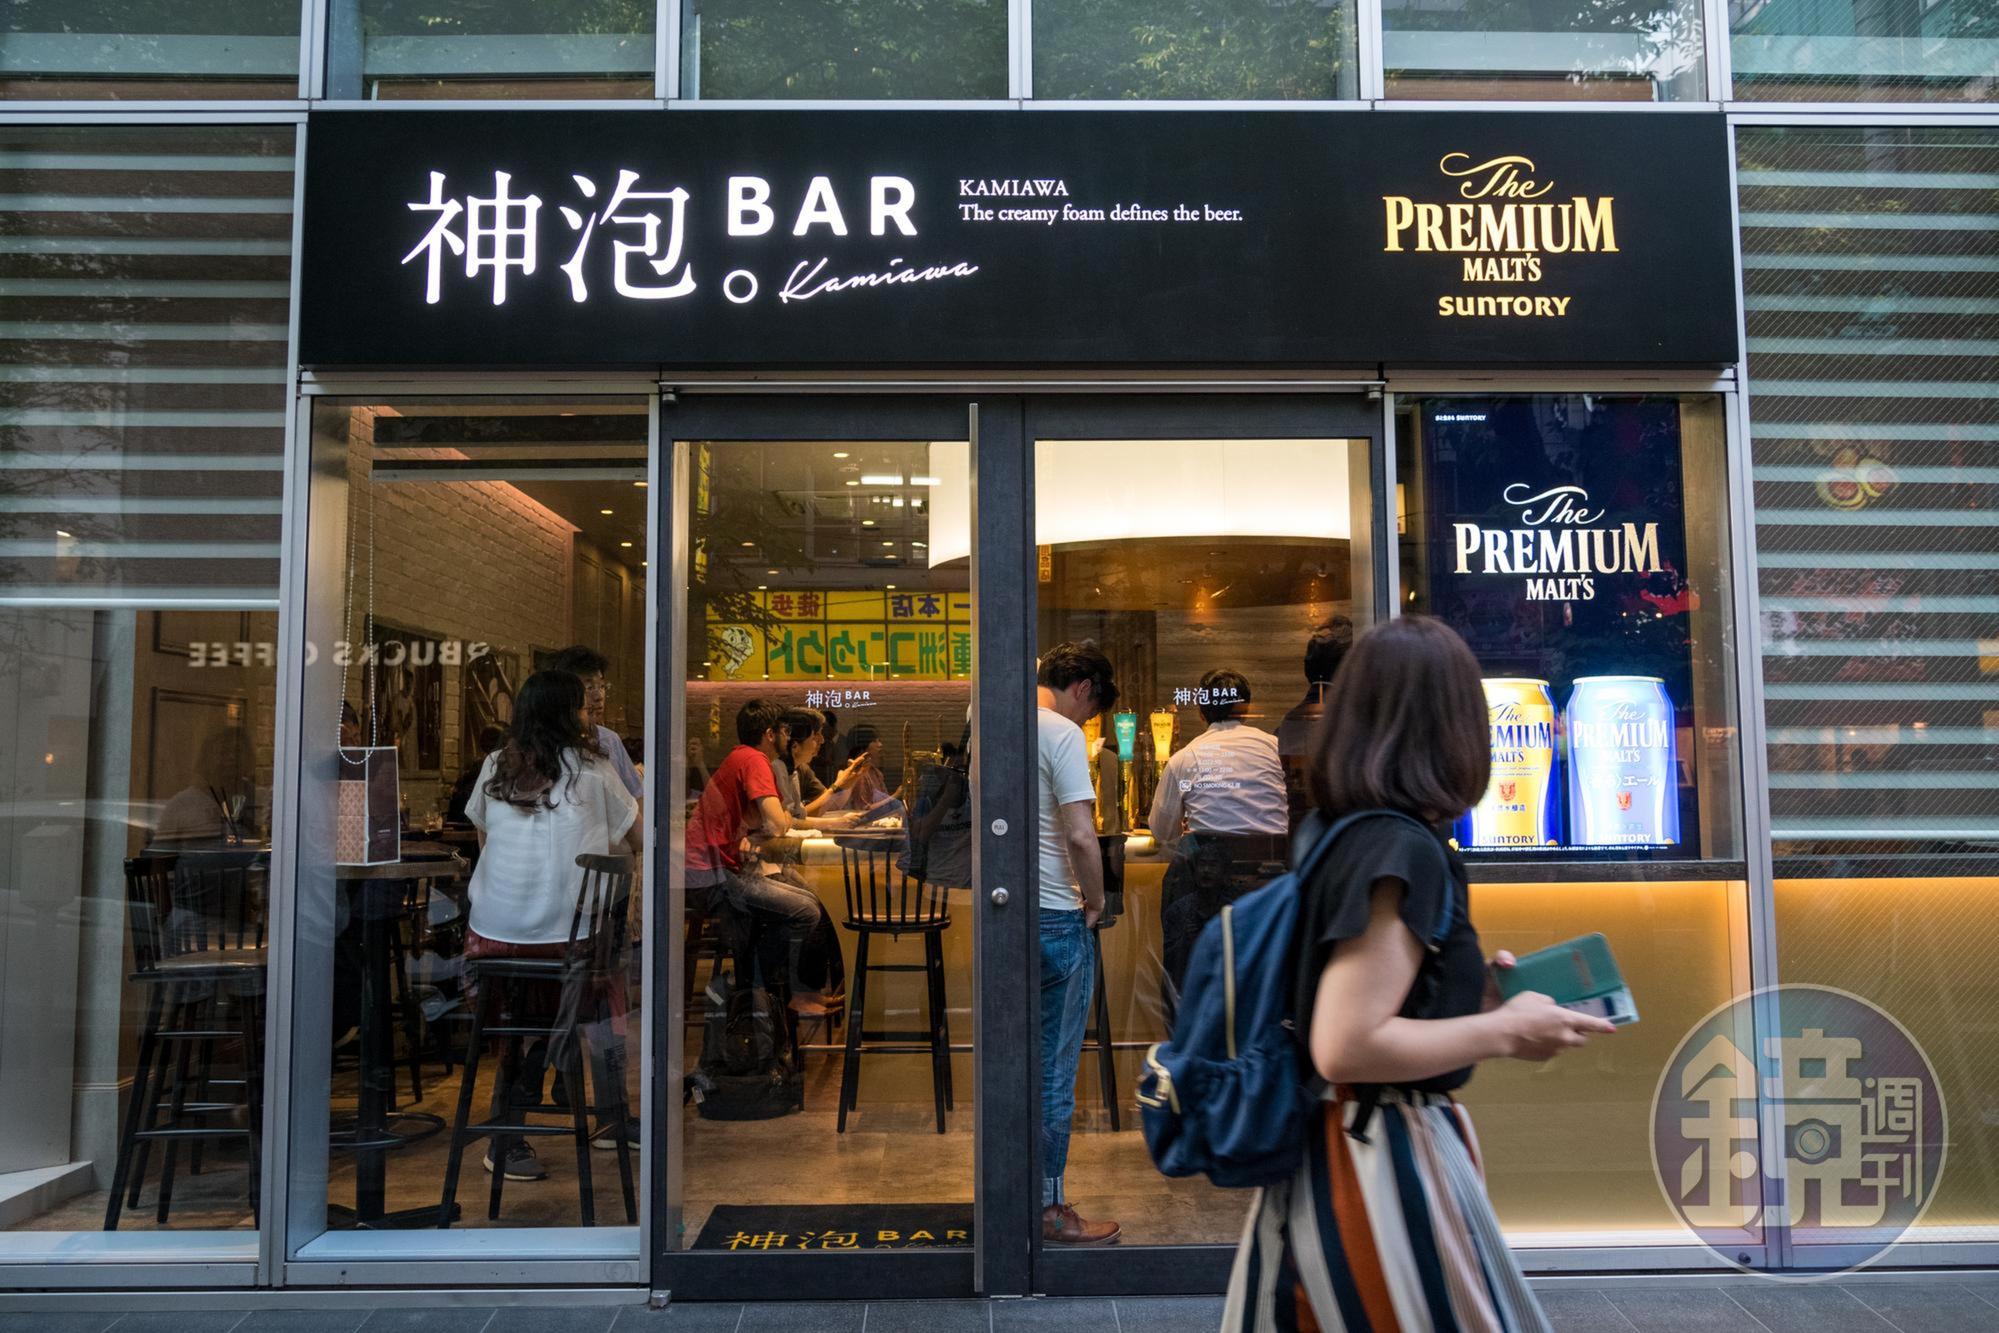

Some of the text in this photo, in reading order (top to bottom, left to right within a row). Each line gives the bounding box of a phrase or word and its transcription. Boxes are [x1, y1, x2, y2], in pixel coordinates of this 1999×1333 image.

[959, 179, 1069, 196] KAMIAWA
[1439, 152, 1554, 198] The
[959, 203, 1244, 225] The creamy foam defines the beer.
[1382, 196, 1620, 253] PREMIUM
[401, 168, 918, 306] 神泡 BAR
[778, 256, 979, 304] Kamiawa
[1462, 253, 1542, 282] MALT'S
[1503, 483, 1605, 526] The
[1453, 521, 1664, 575] PREMIUM
[1525, 573, 1596, 601] MALT'S
[805, 690, 843, 709] 神泡
[845, 690, 870, 700] BAR
[1173, 687, 1211, 706] 神泡
[1212, 687, 1237, 697] BAR
[1573, 719, 1669, 749] PREMIUM
[877, 1230, 968, 1241] BAR
